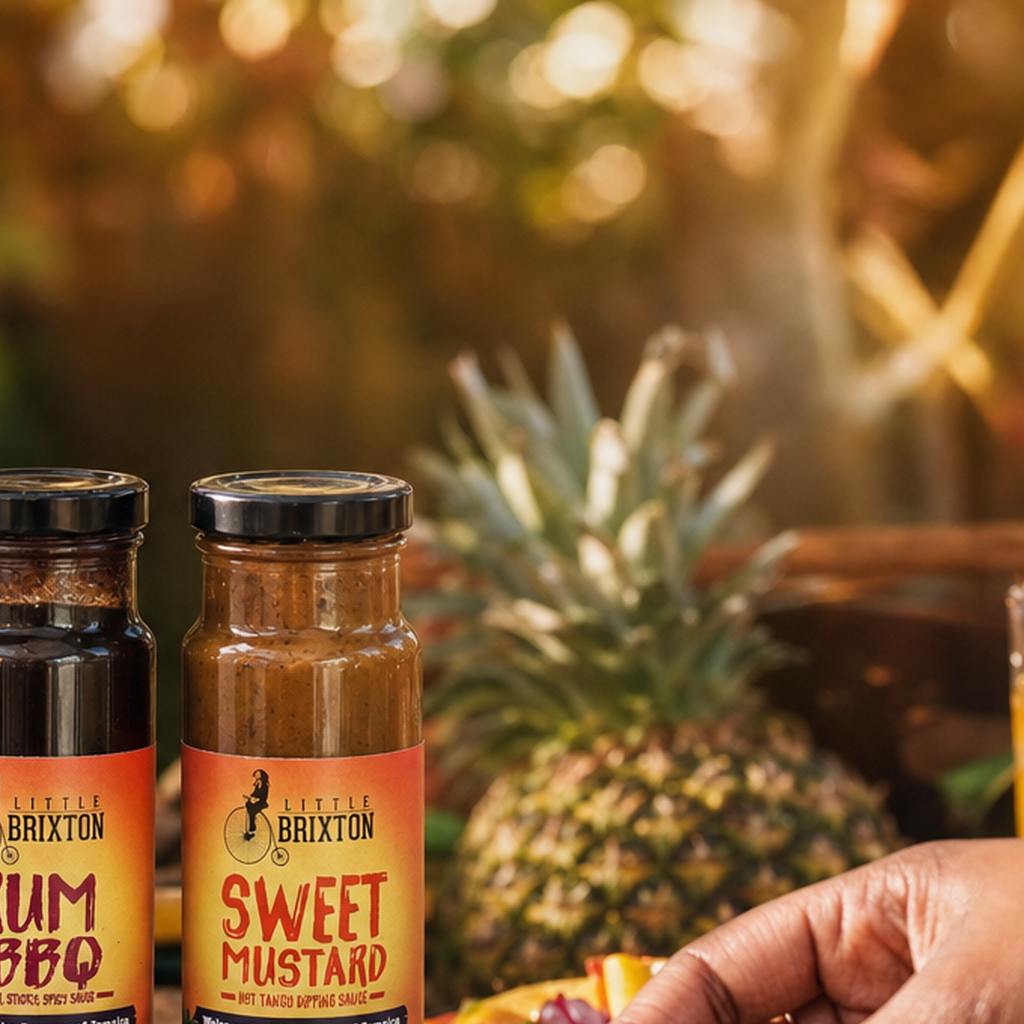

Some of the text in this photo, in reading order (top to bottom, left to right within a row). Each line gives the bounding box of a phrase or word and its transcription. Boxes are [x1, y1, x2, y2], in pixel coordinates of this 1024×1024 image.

[14, 795, 101, 810] LITTLE
[284, 795, 370, 811] LITTLE
[7, 812, 104, 842] BRIXTON
[278, 812, 374, 843] BRIXTON
[221, 872, 387, 944] SWEET
[221, 941, 387, 988] MUSTARD
[238, 991, 256, 1006] HOT
[338, 991, 368, 1007] SAUCE
